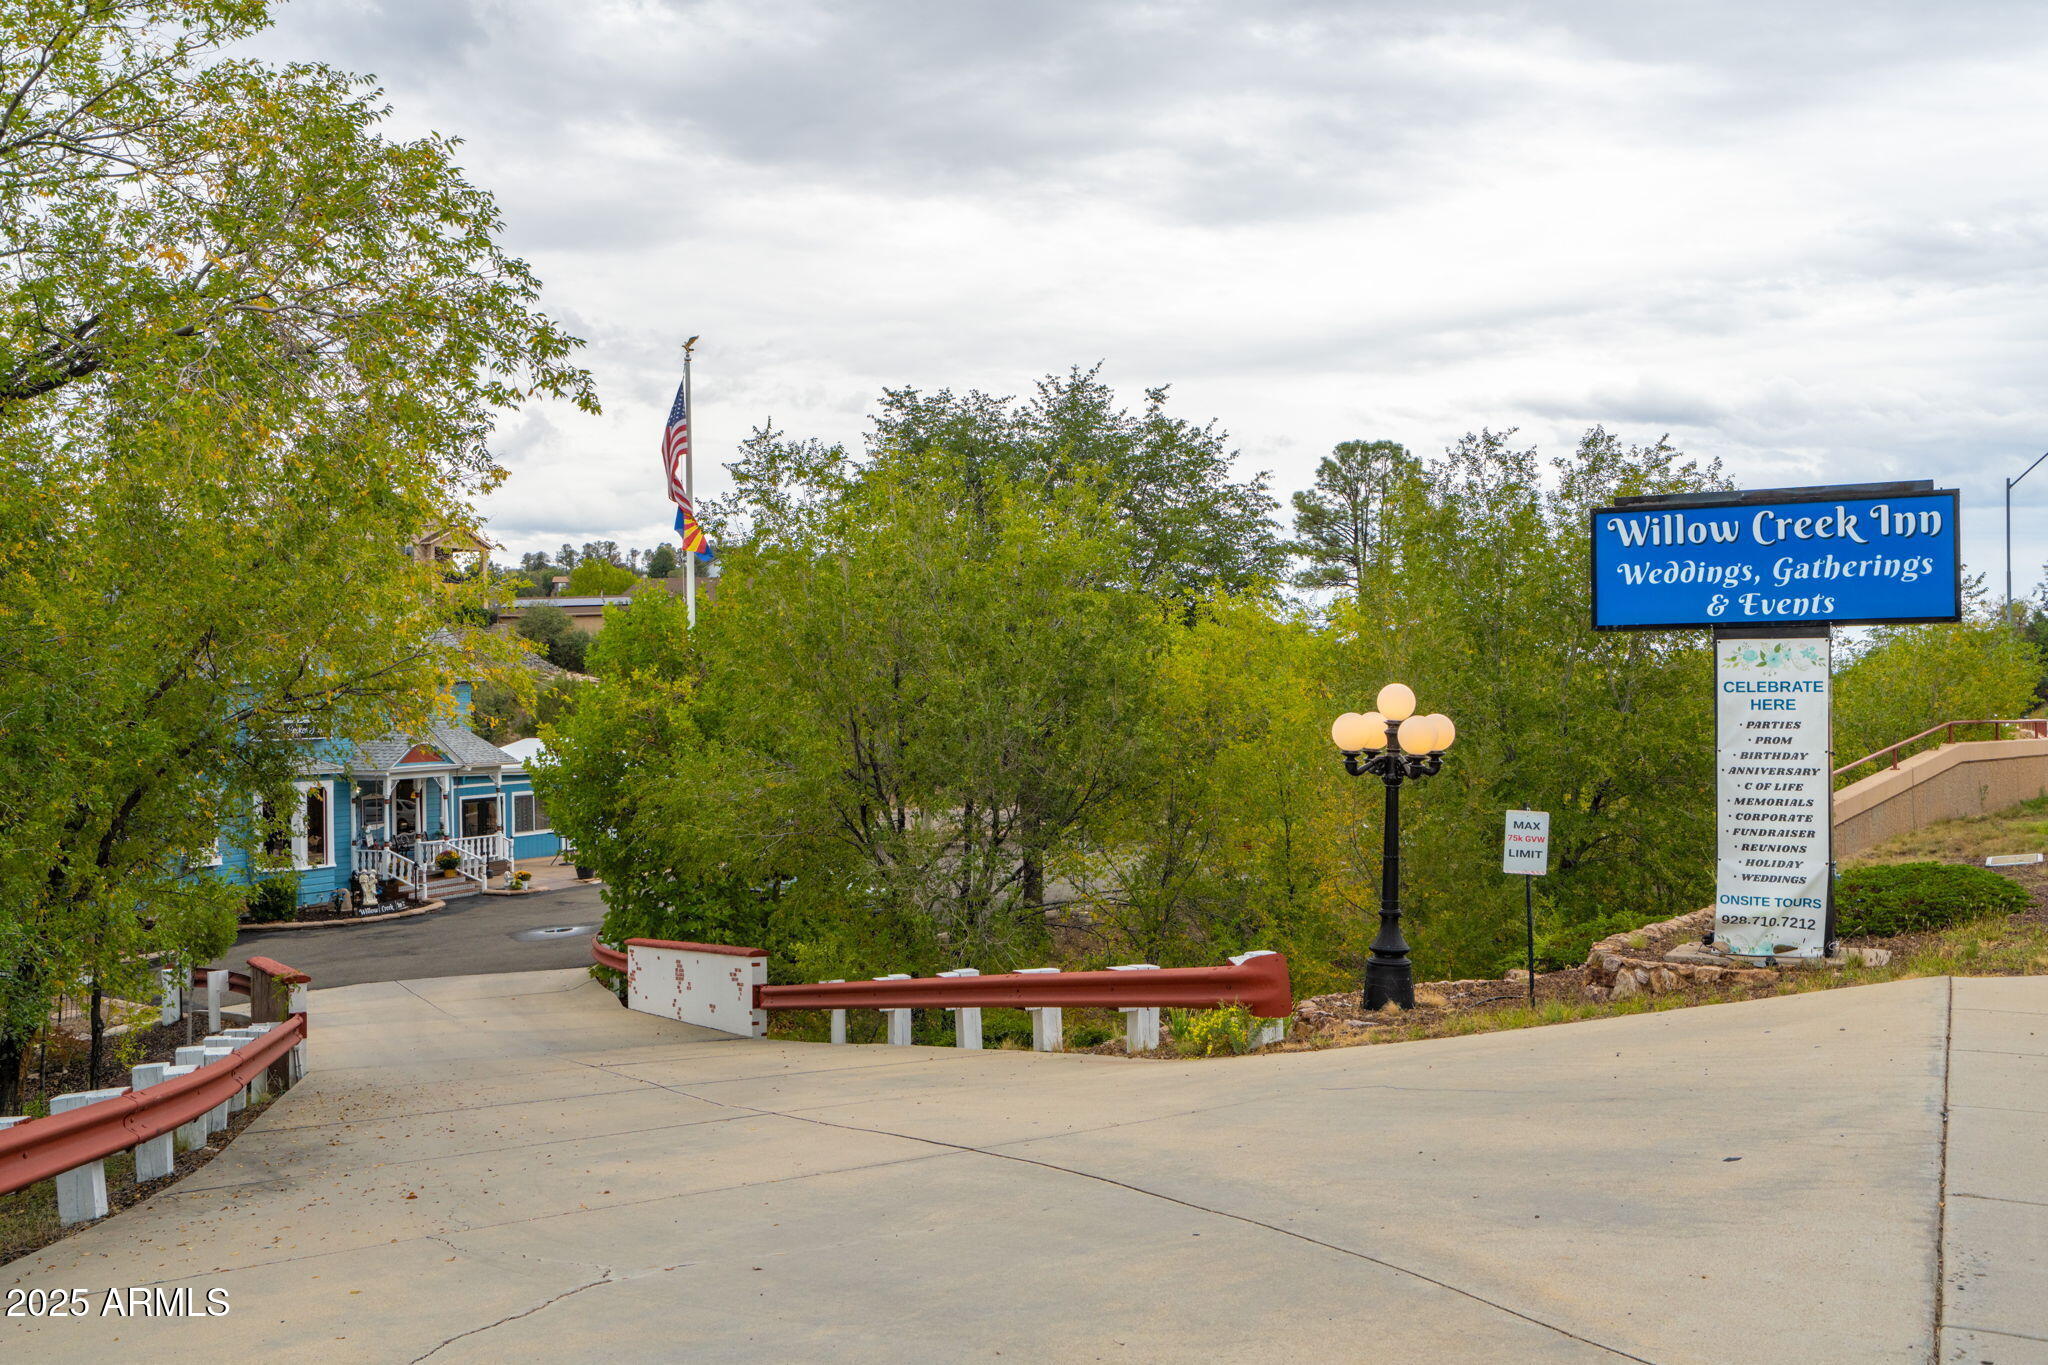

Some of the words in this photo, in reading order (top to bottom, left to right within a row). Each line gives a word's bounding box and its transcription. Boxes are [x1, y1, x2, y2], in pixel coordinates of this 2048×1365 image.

[1607, 514, 1739, 547] Willow
[1752, 506, 1869, 545] Creek
[1870, 504, 1942, 537] Inn
[1617, 560, 1761, 588] Weddings,
[1774, 554, 1933, 587] Gatherings
[1706, 594, 1729, 616] &
[1738, 592, 1835, 617] Events
[1723, 680, 1824, 693] CELEBRATE
[1750, 698, 1797, 711] HERE
[1746, 721, 1802, 730] PARTIES
[1755, 736, 1793, 745] PROM
[1740, 751, 1809, 761] BIRTHDAY
[1728, 766, 1821, 776] ANNIVERSARY
[1744, 782, 1752, 790] C
[1755, 783, 1772, 791] OF
[1773, 783, 1804, 791] LIFE
[1734, 797, 1814, 807] MEMORIALS
[1735, 812, 1814, 823] CORPORATE
[1513, 821, 1541, 830] MAX
[1732, 828, 1816, 838] FUNDRAISER
[1525, 835, 1545, 843] GVW
[1741, 843, 1808, 853] REUNIONS
[1508, 849, 1543, 859] LIMIT
[1744, 858, 1804, 869] HOLIDAY
[1741, 873, 1807, 885] WEDDINGS
[1720, 894, 1771, 907] ONSITE
[1774, 897, 1822, 909] TOURS
[1721, 915, 1816, 931] 928.710.7212
